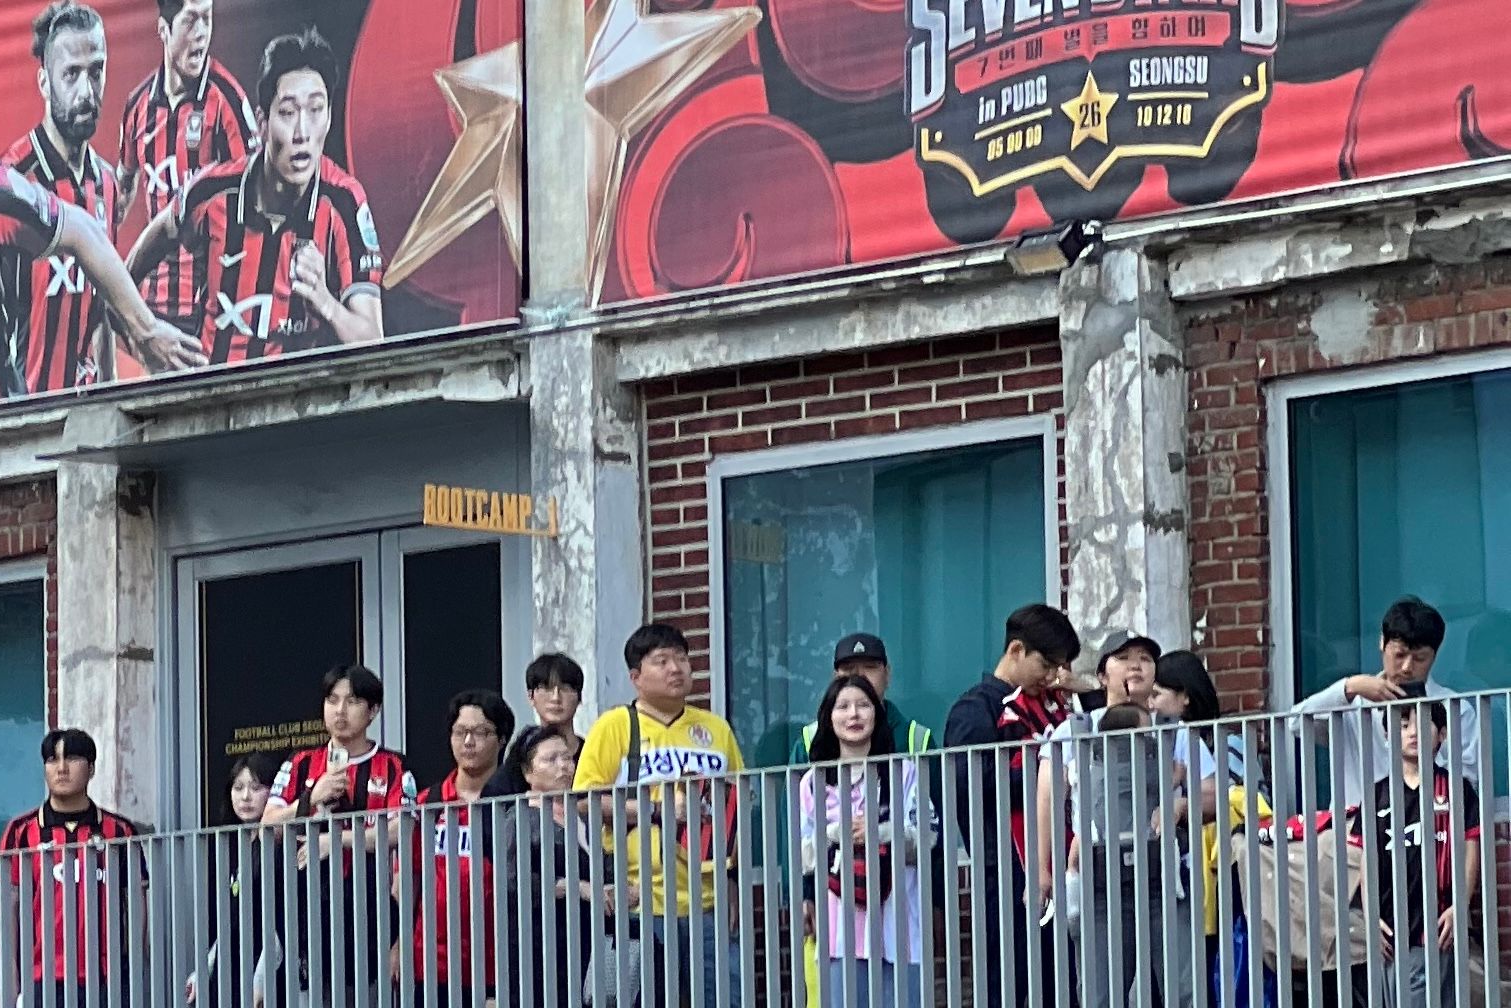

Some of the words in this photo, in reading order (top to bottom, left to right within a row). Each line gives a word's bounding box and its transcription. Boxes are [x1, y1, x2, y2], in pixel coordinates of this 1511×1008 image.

[1129, 55, 1209, 88] SEONGSU
[978, 96, 996, 124] in
[1079, 101, 1102, 130] 26
[1137, 105, 1153, 127] 10
[1157, 103, 1173, 126] 12
[424, 483, 532, 532] BOOTCAMP
